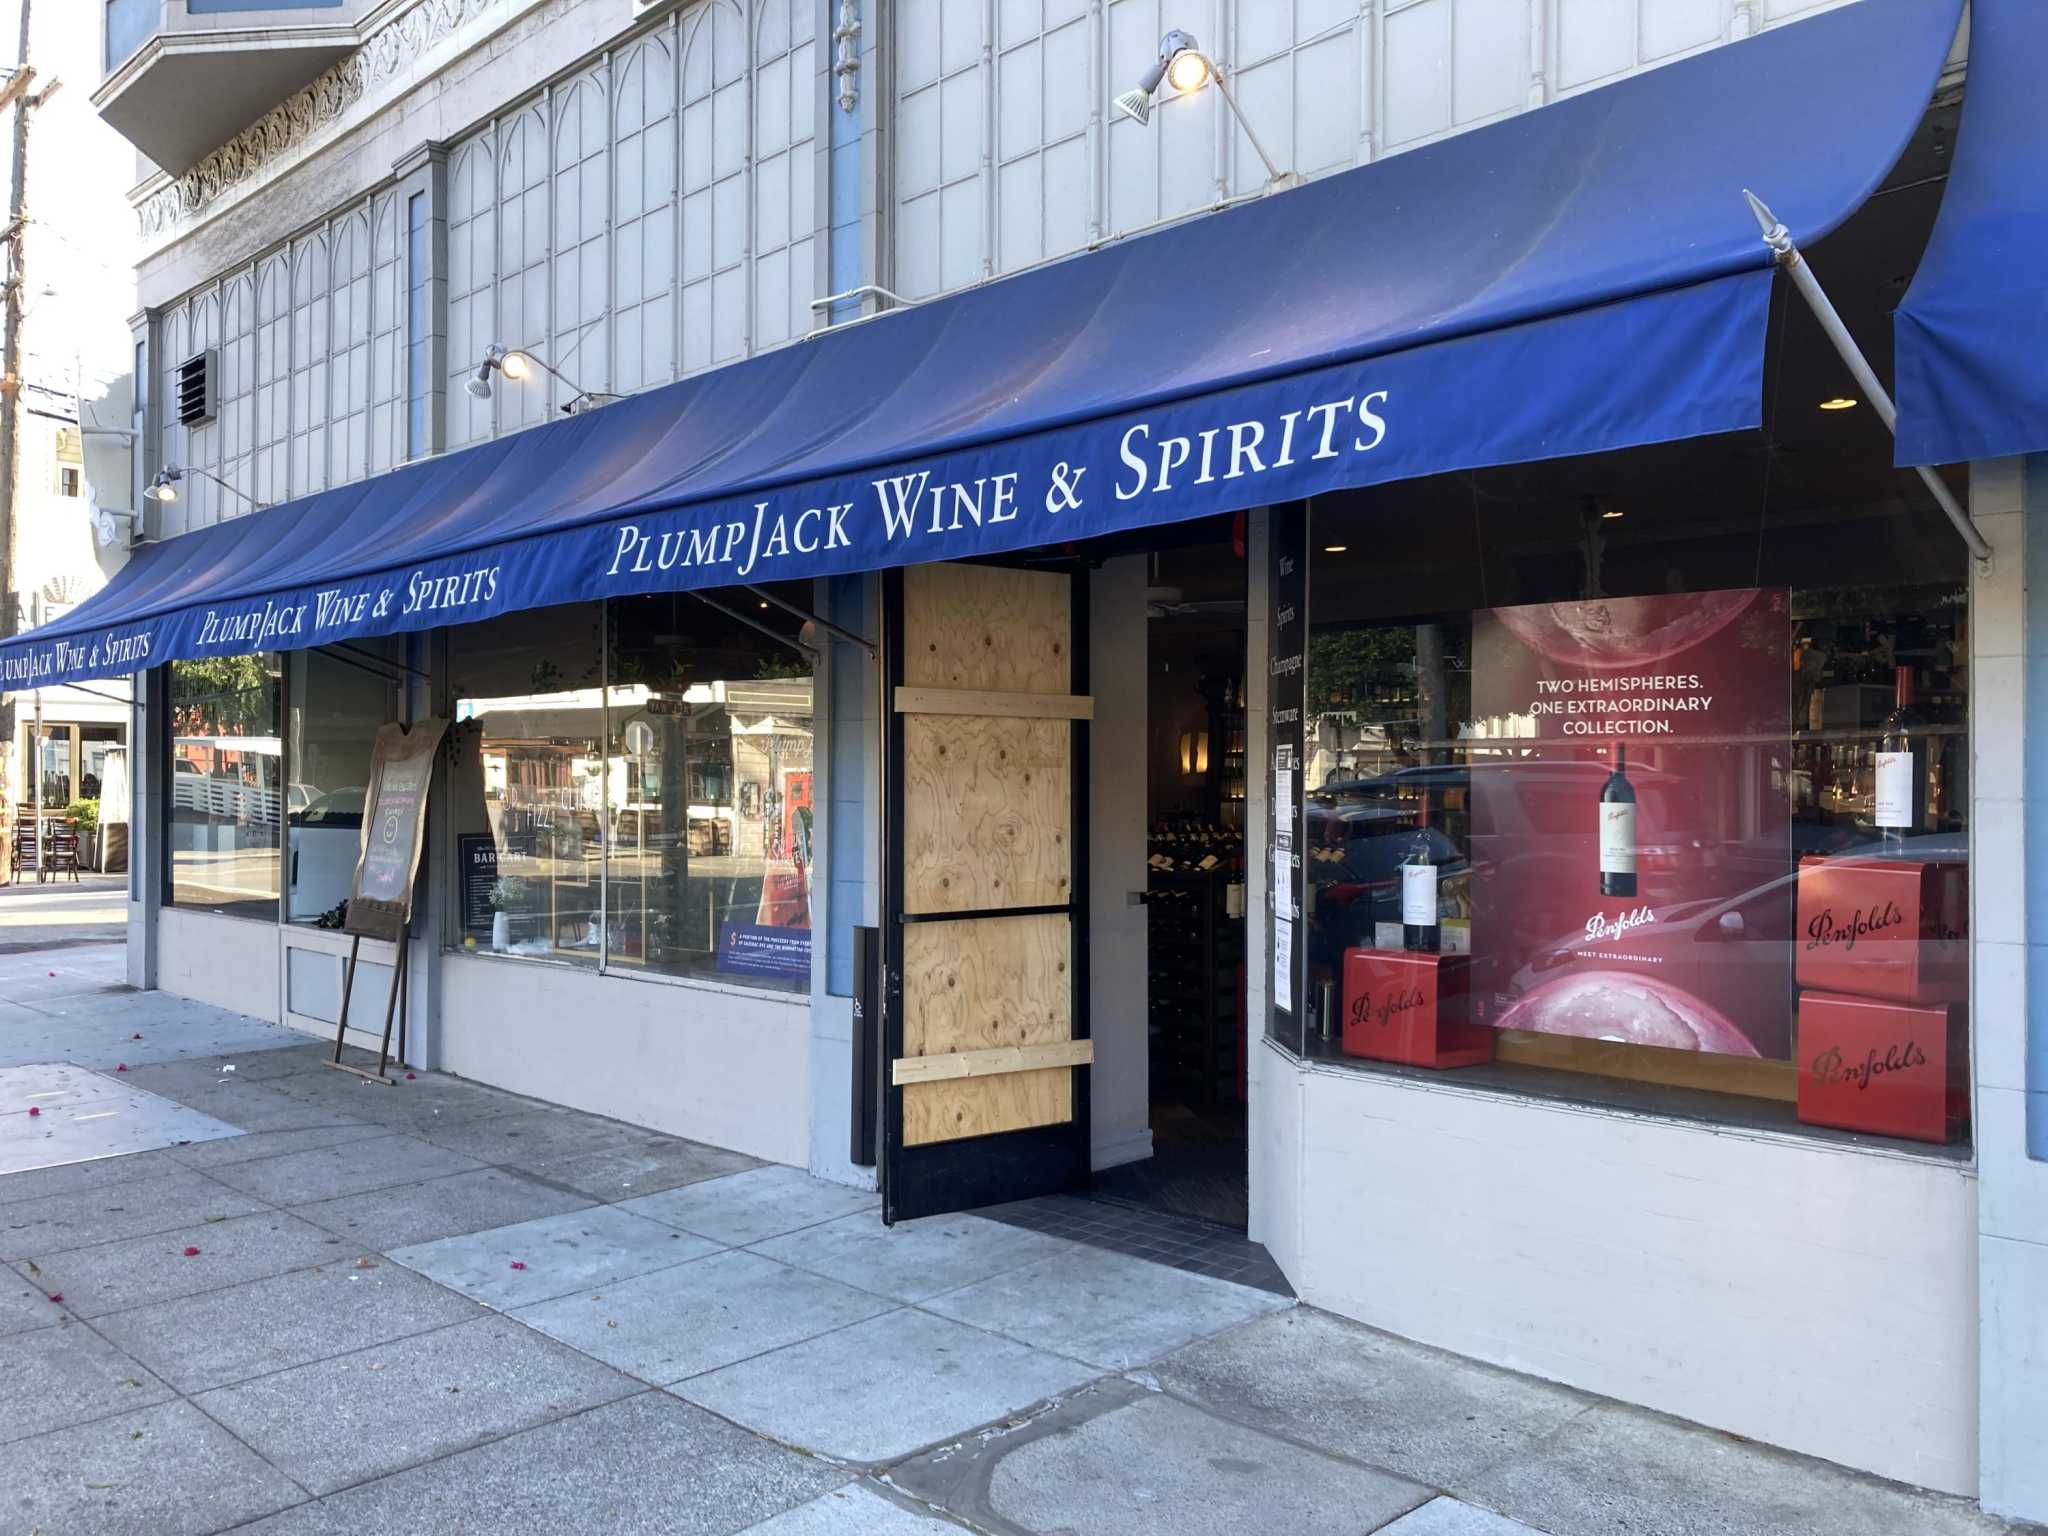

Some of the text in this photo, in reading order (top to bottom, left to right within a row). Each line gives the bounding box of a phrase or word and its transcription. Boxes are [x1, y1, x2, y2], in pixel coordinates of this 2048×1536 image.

[607, 391, 1388, 576] PLUMPJACK WINE & SPIRITS
[1279, 555, 1294, 576] Wine
[196, 567, 500, 648] PLUMPJACK WINE & SPIRITS
[1276, 603, 1295, 632] Spirits
[0, 632, 151, 686] LUMPJACK WINE & SPIRITS
[1271, 654, 1302, 676] Champagne
[1537, 675, 1704, 694] TWO HEMISPHERES.
[1272, 704, 1298, 725] Stemware
[1530, 697, 1713, 715] ONE EXTRAORDINARY
[1563, 720, 1674, 734] COLLECTION.
[527, 803, 553, 827] FIZZ
[473, 852, 496, 864] BAR
[1585, 906, 1655, 941] Penfolds
[1807, 902, 1903, 950] Penfolds
[1599, 952, 1663, 963] EXTRAORDINARY
[1809, 1041, 1926, 1090] Penfolds
